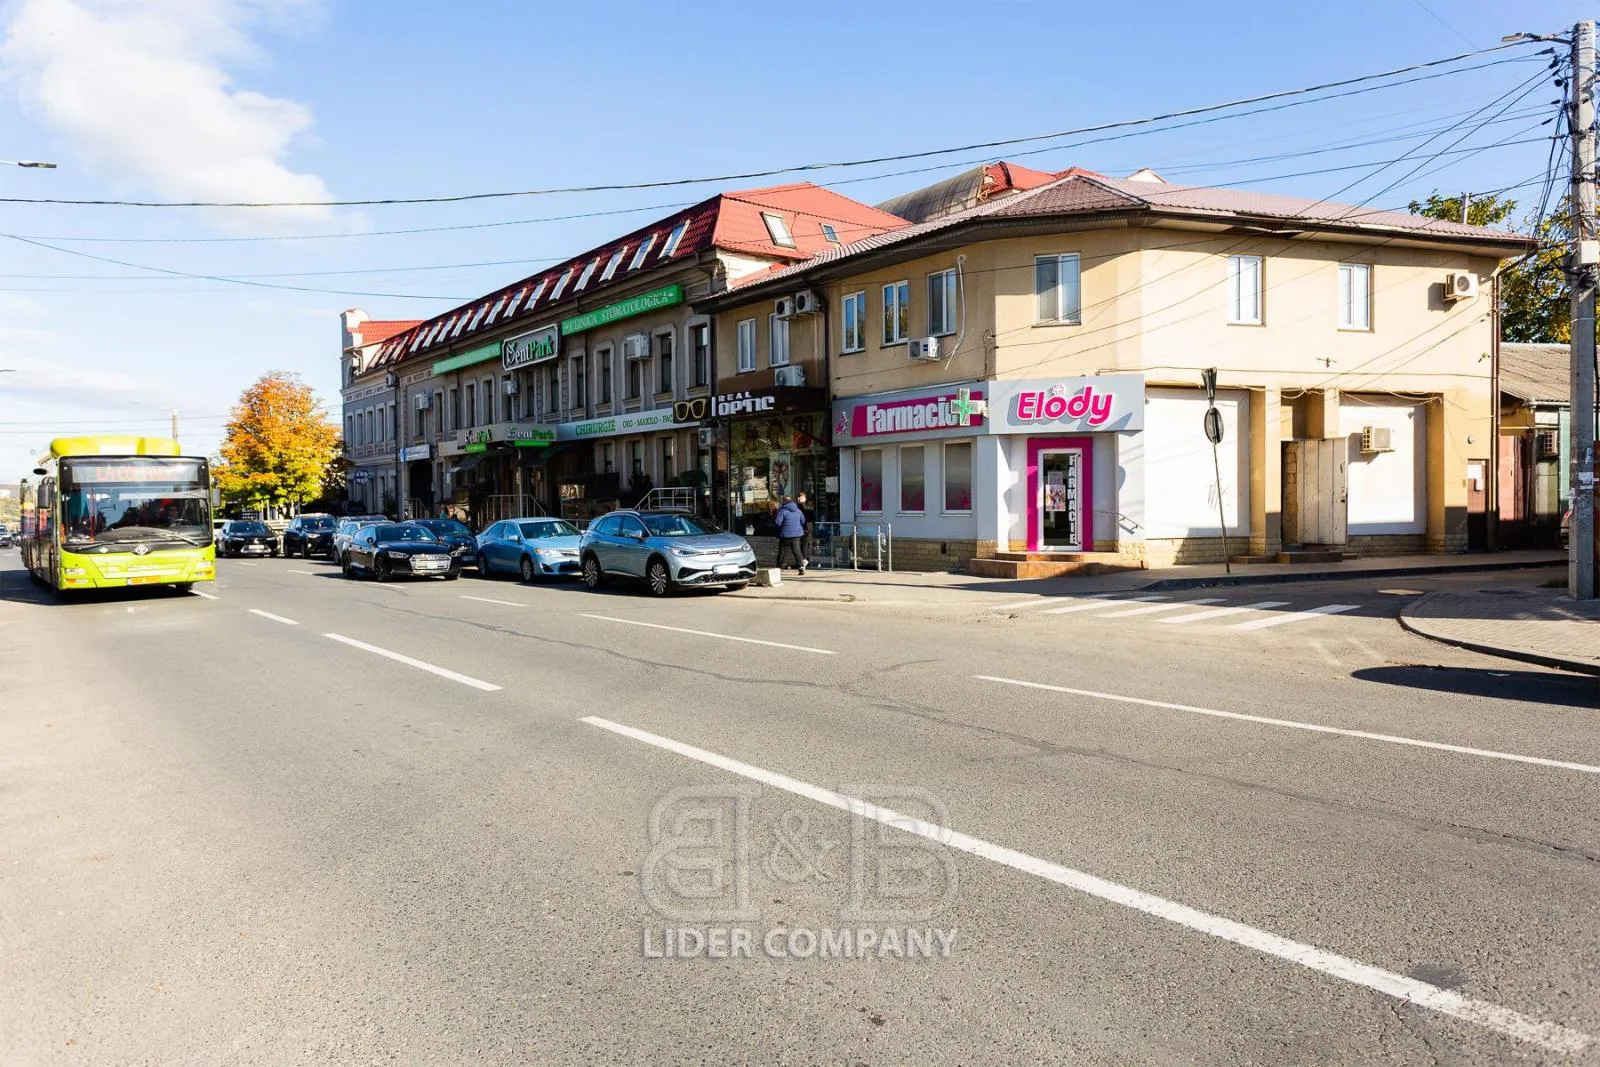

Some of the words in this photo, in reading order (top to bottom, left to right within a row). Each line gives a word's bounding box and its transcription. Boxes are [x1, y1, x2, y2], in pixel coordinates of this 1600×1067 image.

[718, 391, 751, 402] REAL
[1016, 386, 1113, 425] Elody
[575, 420, 616, 436] CHIRURGIE
